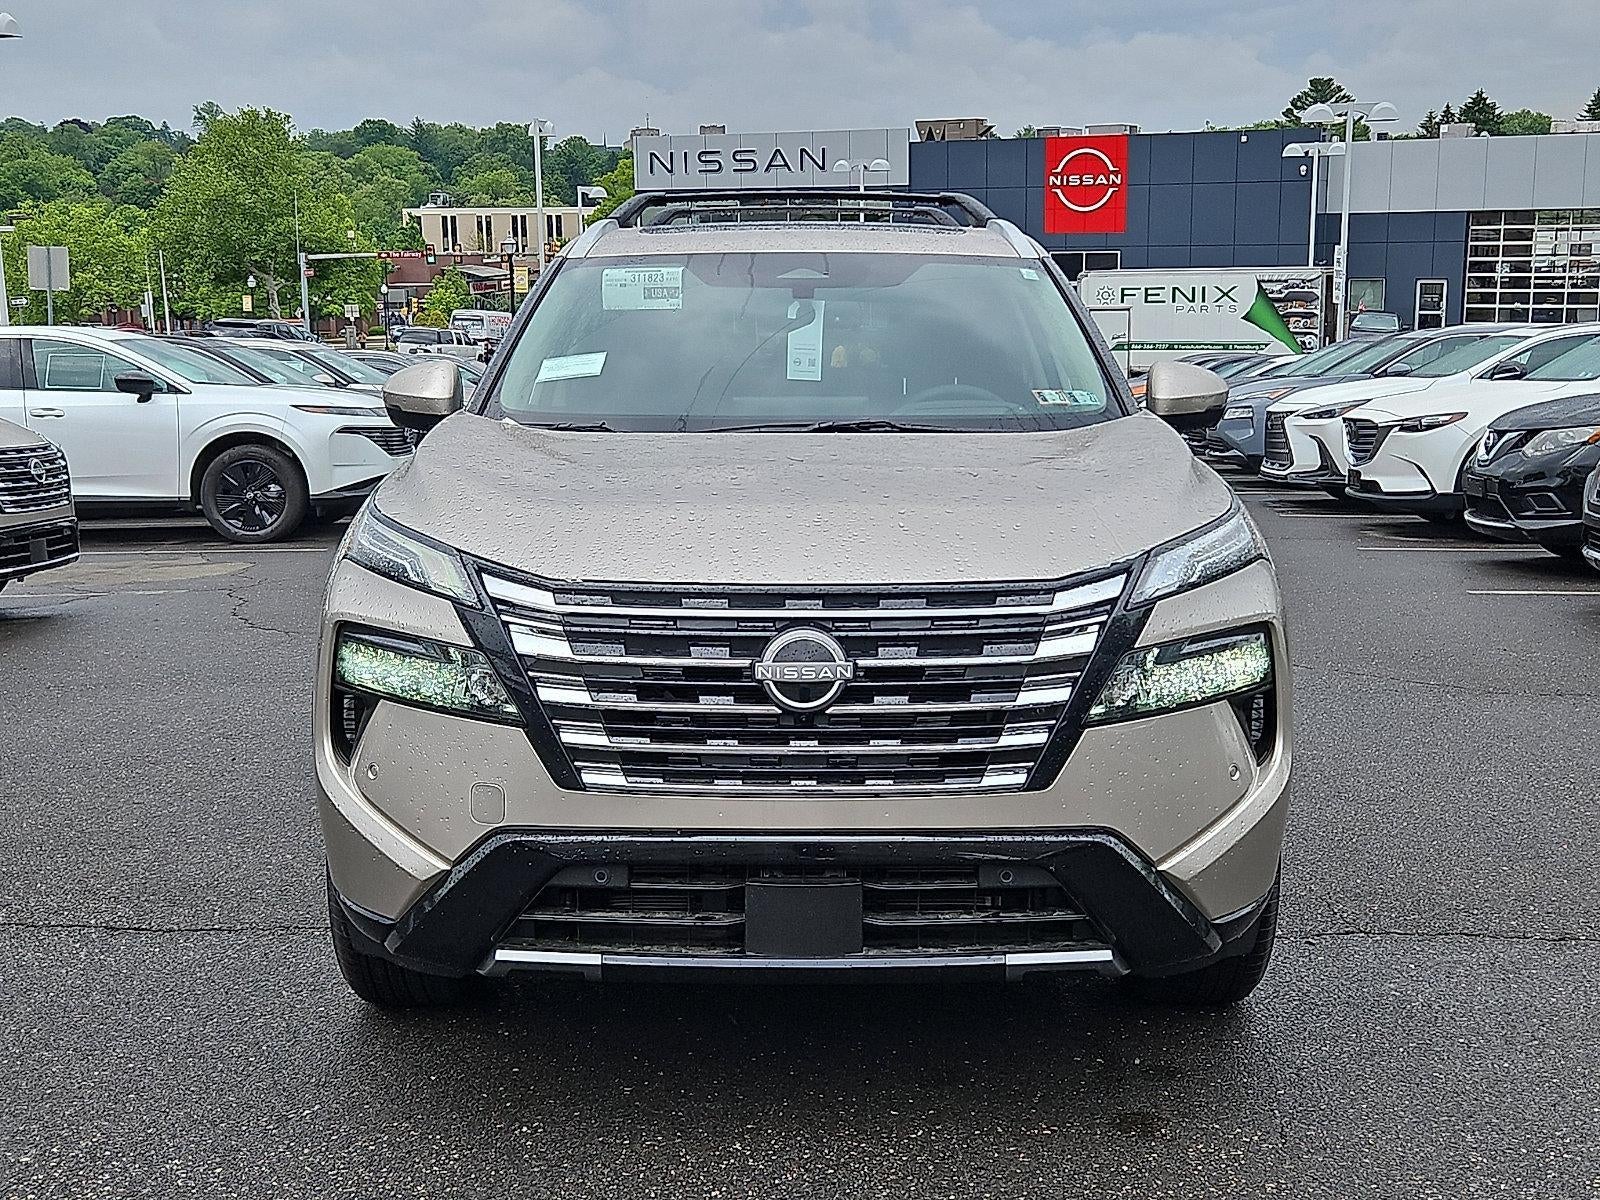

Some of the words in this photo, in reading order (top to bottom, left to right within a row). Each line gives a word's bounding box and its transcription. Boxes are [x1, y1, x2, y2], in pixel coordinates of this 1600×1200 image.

[648, 147, 828, 176] NISSAN
[1048, 173, 1123, 187] NISSAN
[400, 251, 422, 259] Fairway
[630, 273, 665, 283] 311823
[651, 288, 669, 298] USA
[1119, 285, 1240, 304] FENIX
[1174, 304, 1238, 314] PARTS
[756, 665, 852, 680] NISSAN
